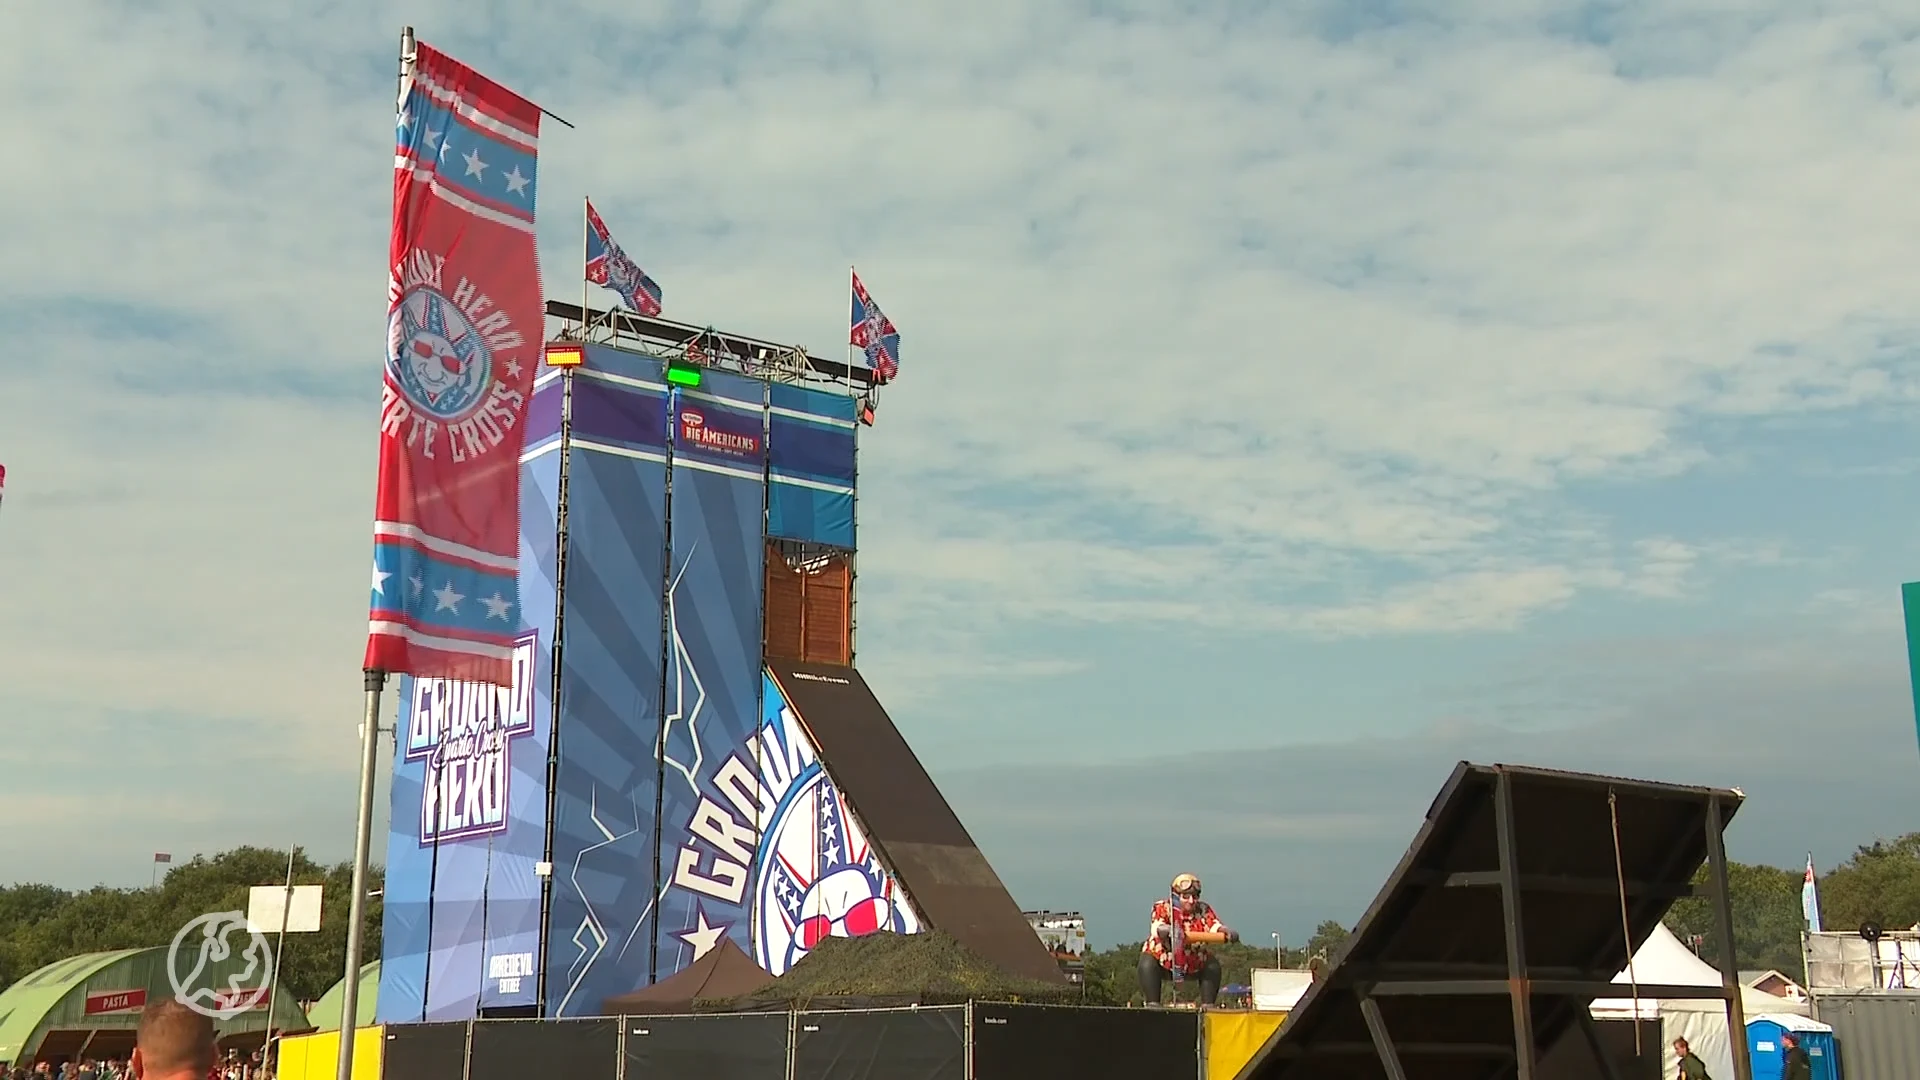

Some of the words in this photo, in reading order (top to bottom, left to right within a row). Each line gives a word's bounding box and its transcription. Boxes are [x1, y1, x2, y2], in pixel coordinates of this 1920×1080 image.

[451, 275, 525, 351] HERO
[447, 380, 524, 464] CROSS
[685, 426, 700, 441] BIG
[702, 426, 754, 451] AMERICANS
[425, 754, 506, 834] HERO
[102, 995, 129, 1009] PASTA
